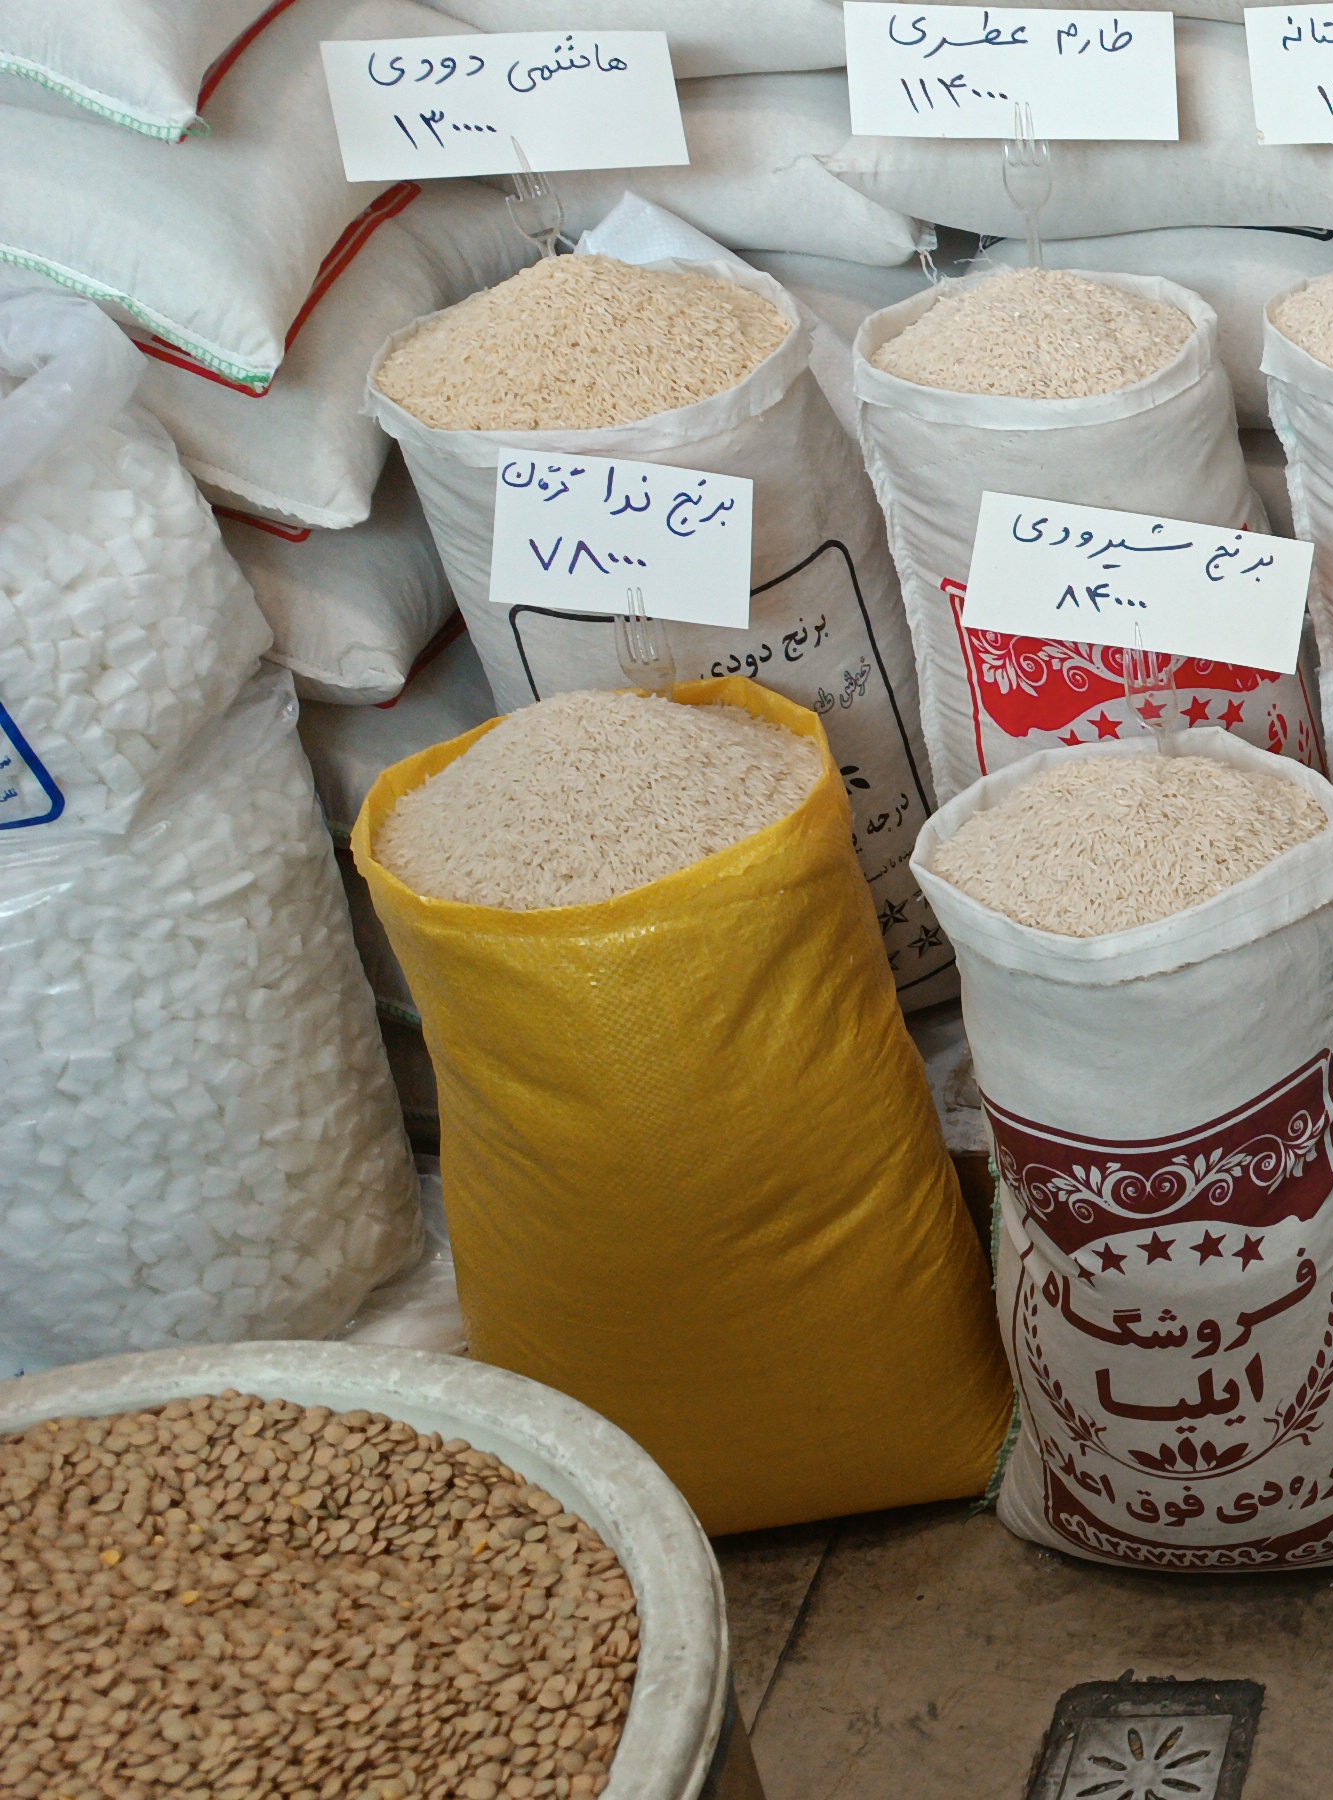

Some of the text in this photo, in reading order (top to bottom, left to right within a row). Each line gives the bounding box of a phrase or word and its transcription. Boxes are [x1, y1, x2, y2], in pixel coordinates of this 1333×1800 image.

[889, 11, 1132, 58] طارم عطری
[368, 35, 627, 92] هاشمی دودی
[901, 74, 1008, 113] ۱۱۴۰۰۰
[394, 110, 496, 149] ۱۳۰۰۰۰
[604, 466, 650, 515] ندا
[666, 479, 734, 537] برنج
[529, 537, 646, 574] ۷۸۰۰۰
[1013, 514, 1273, 582] برنج شیرودی
[1056, 583, 1147, 612] ۸۴۰۰۰
[782, 613, 829, 662] برنج
[867, 792, 909, 835] درجه
[1042, 1247, 1316, 1359] فروشگاه
[1095, 1353, 1264, 1434] ایلیا
[1126, 1486, 1205, 1527] فوق
